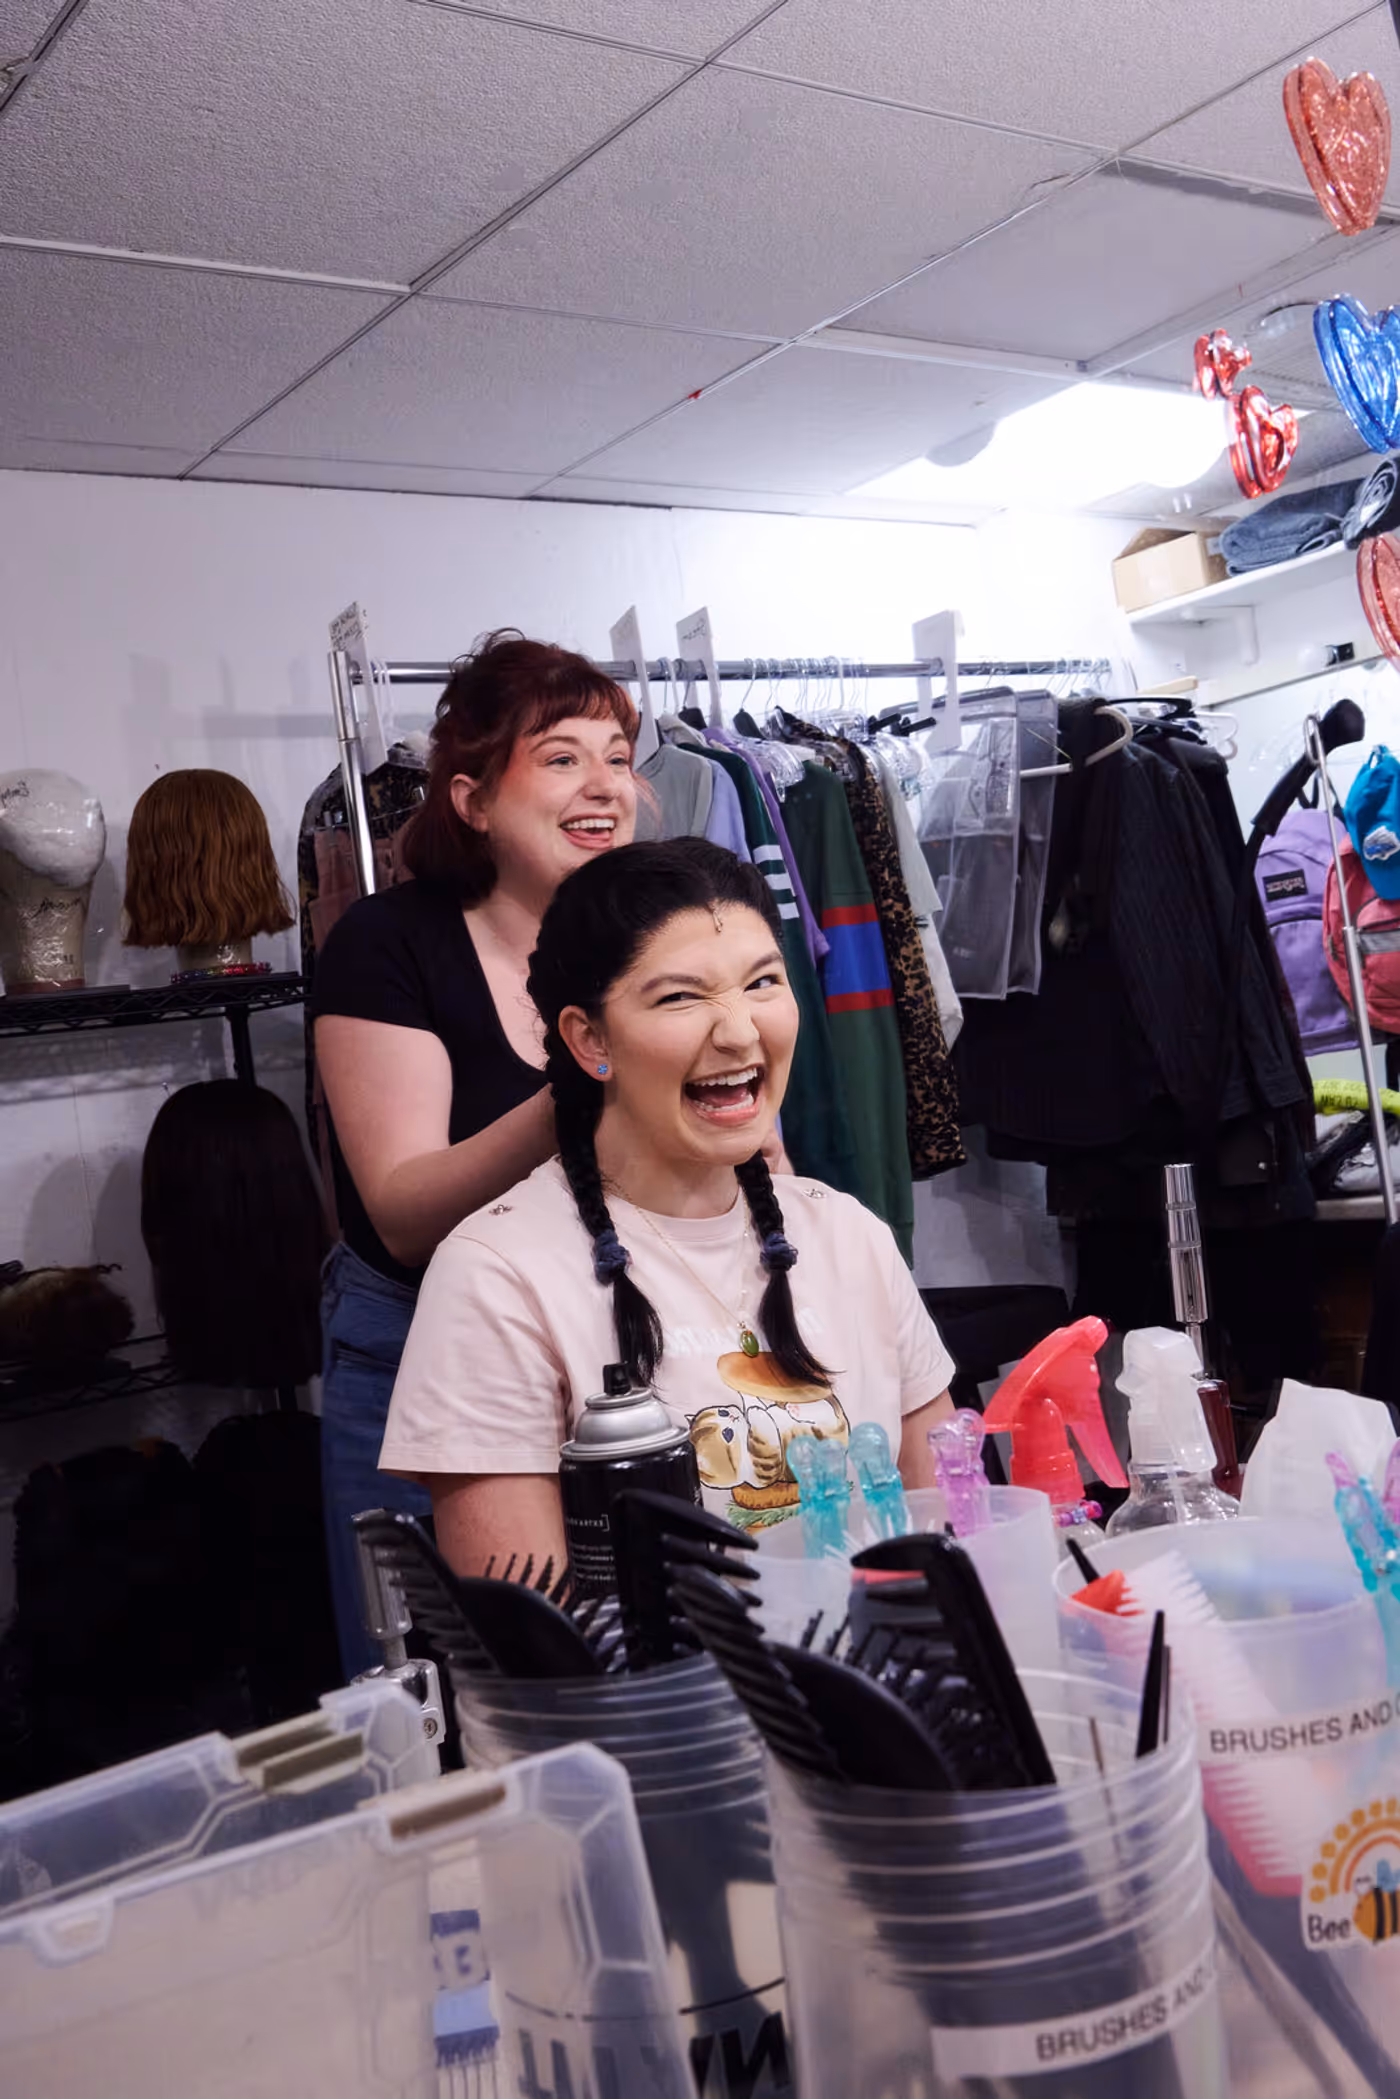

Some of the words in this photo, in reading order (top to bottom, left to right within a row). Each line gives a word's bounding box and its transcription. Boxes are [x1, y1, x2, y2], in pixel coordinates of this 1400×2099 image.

[1209, 1716, 1343, 1753] BRUSHES
[1350, 1700, 1393, 1736] AND
[1307, 1914, 1351, 1943] Bee
[1036, 1994, 1167, 2062] BRUSHES
